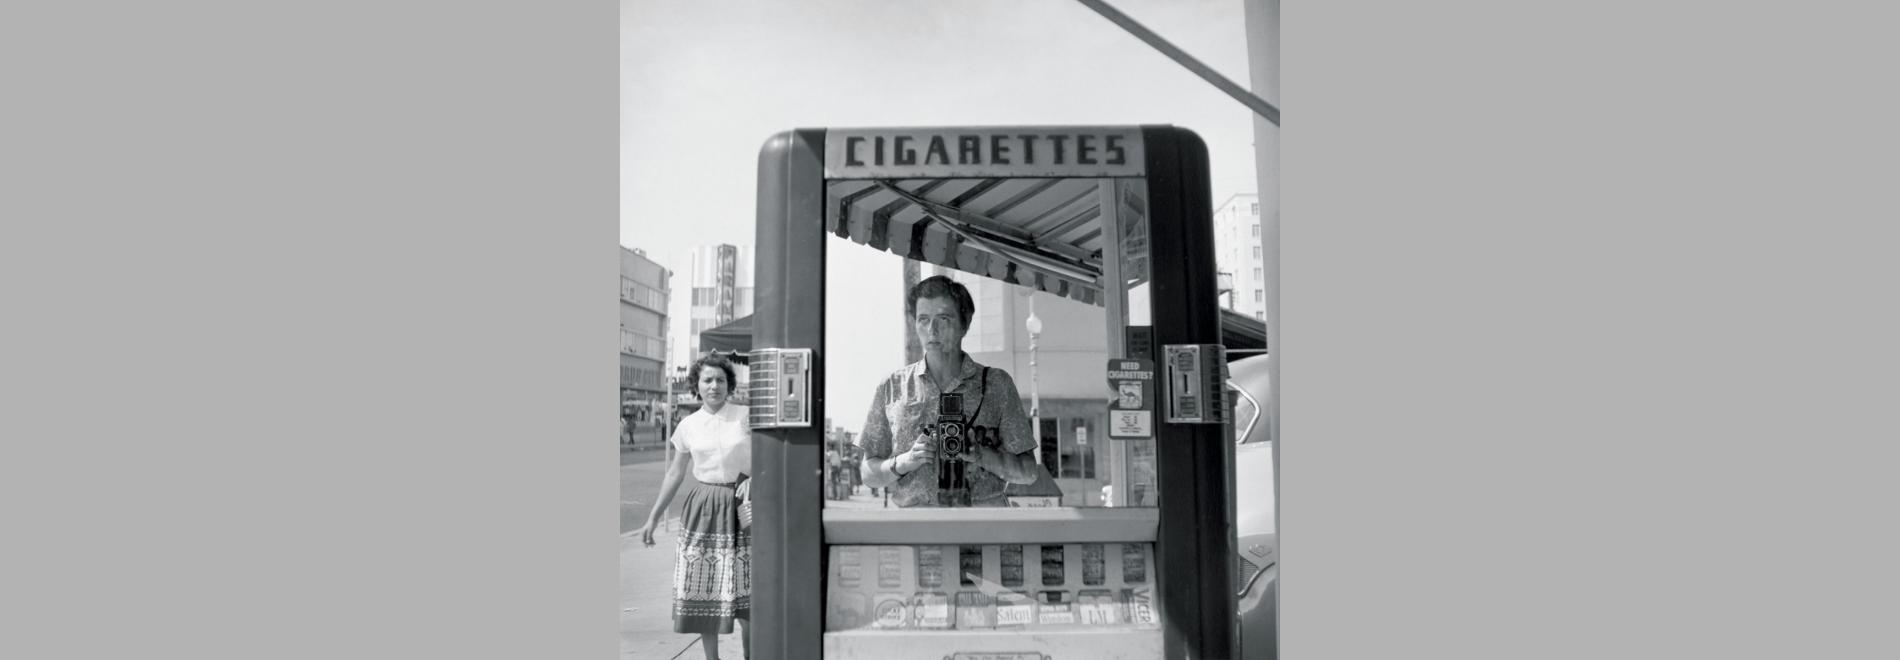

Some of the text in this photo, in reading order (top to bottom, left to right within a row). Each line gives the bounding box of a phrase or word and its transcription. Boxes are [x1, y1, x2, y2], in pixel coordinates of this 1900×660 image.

[845, 135, 1126, 166] CIGARETTES
[1121, 362, 1140, 370] NEED
[1108, 370, 1153, 379] CIGARETTES?
